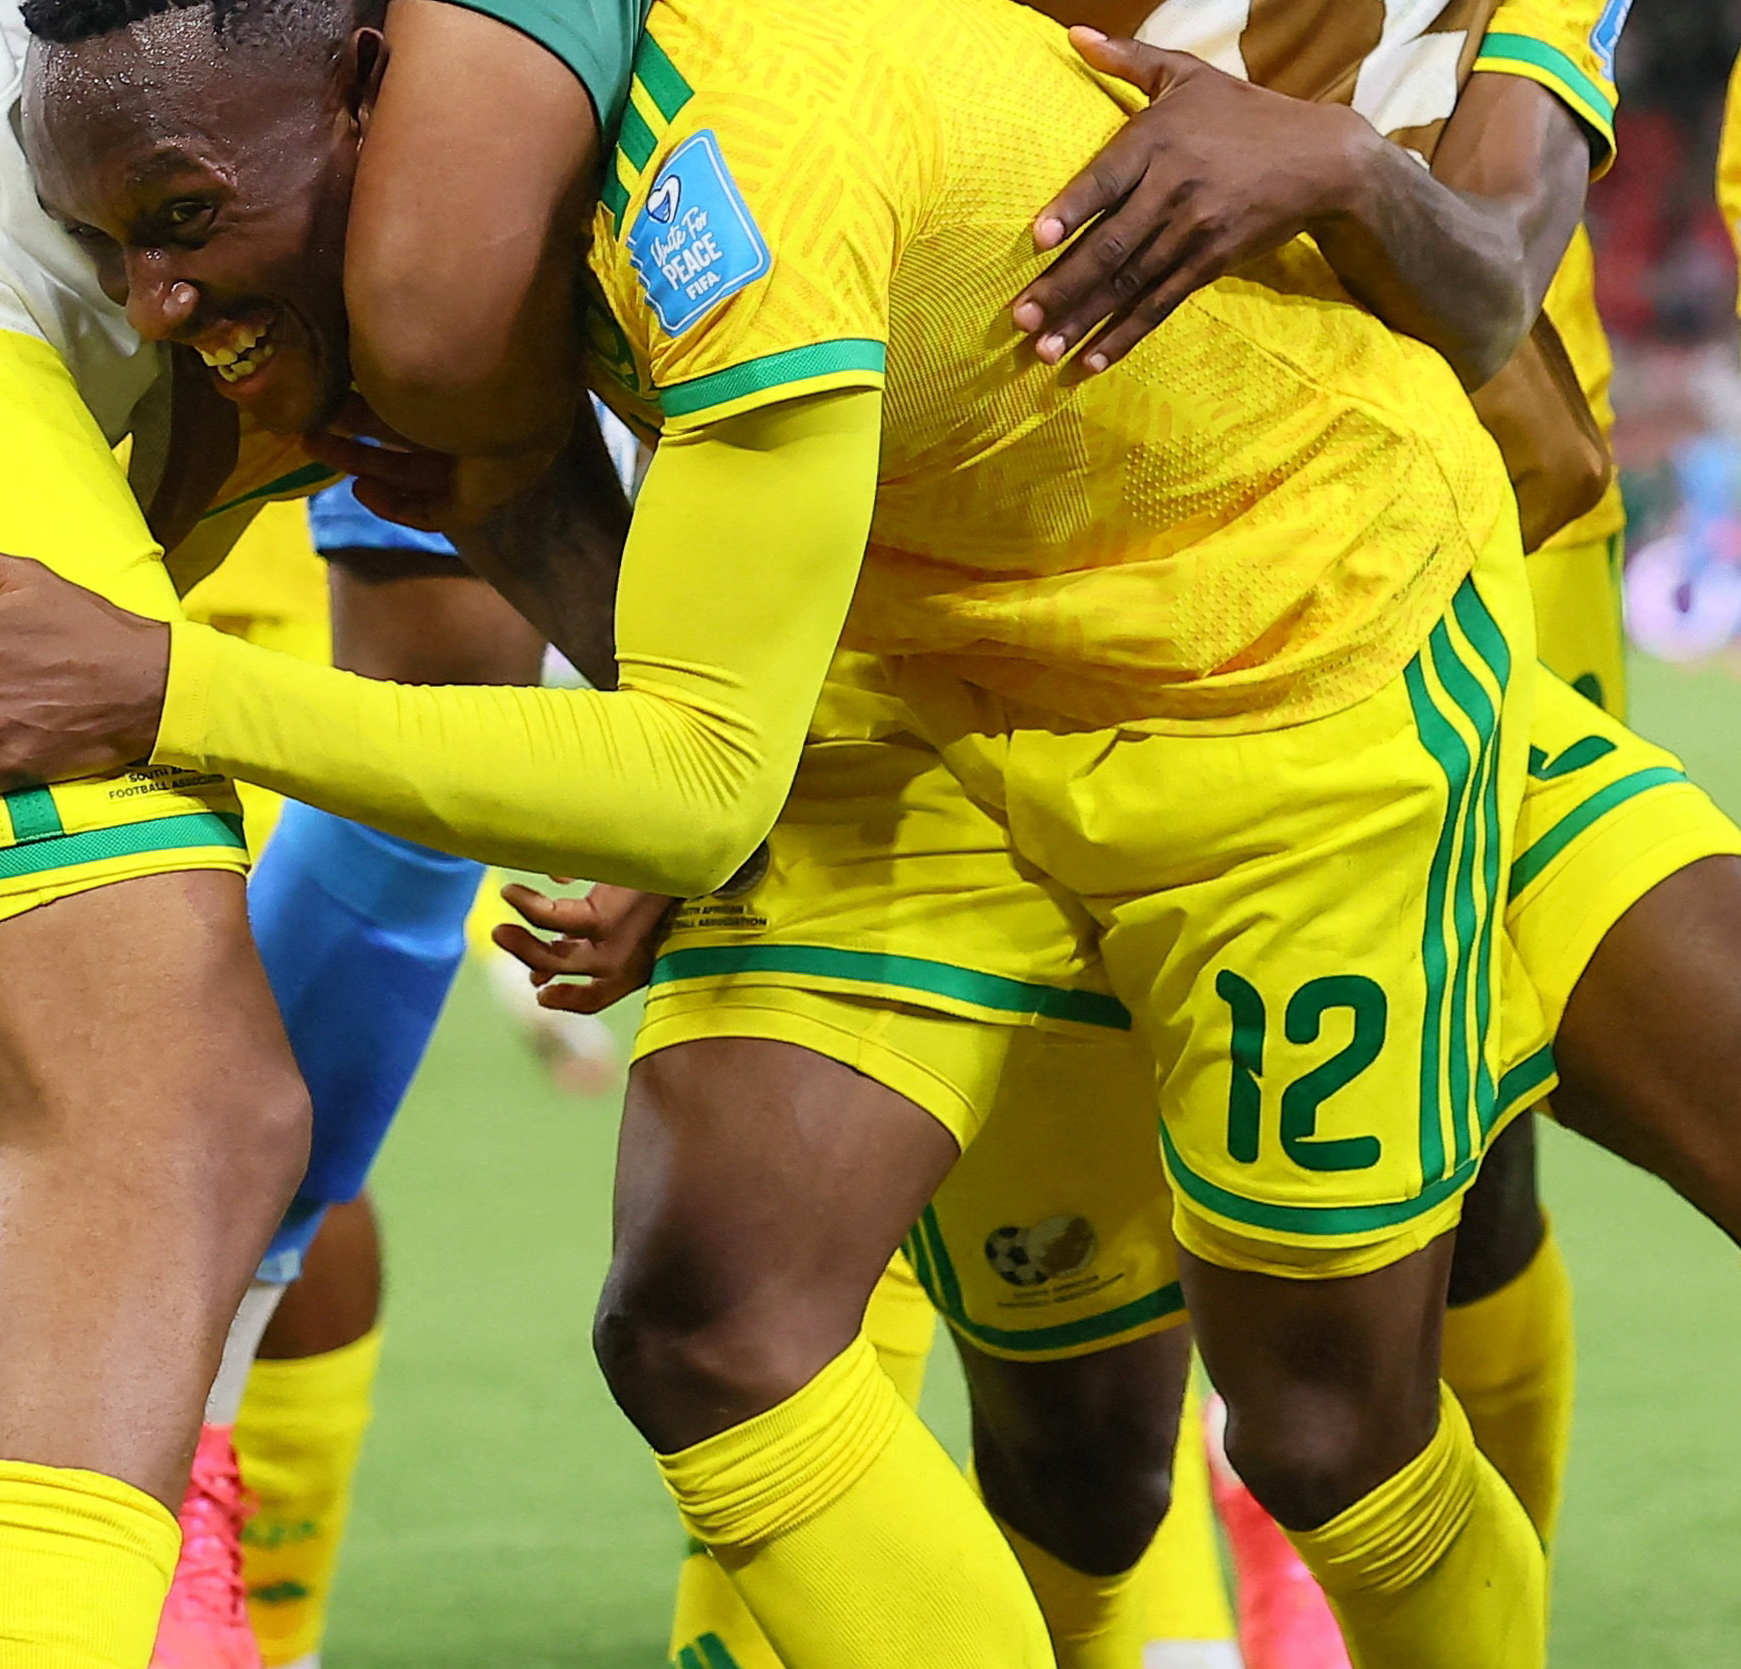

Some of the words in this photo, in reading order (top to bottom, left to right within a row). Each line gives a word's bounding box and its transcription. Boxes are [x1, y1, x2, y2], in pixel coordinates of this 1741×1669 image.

[650, 225, 687, 268] Unite
[681, 206, 708, 241] For
[662, 231, 723, 292] PEACE
[685, 270, 722, 301] FIFA
[108, 781, 171, 800] FOOTBALL
[1215, 969, 1388, 1173] 12
